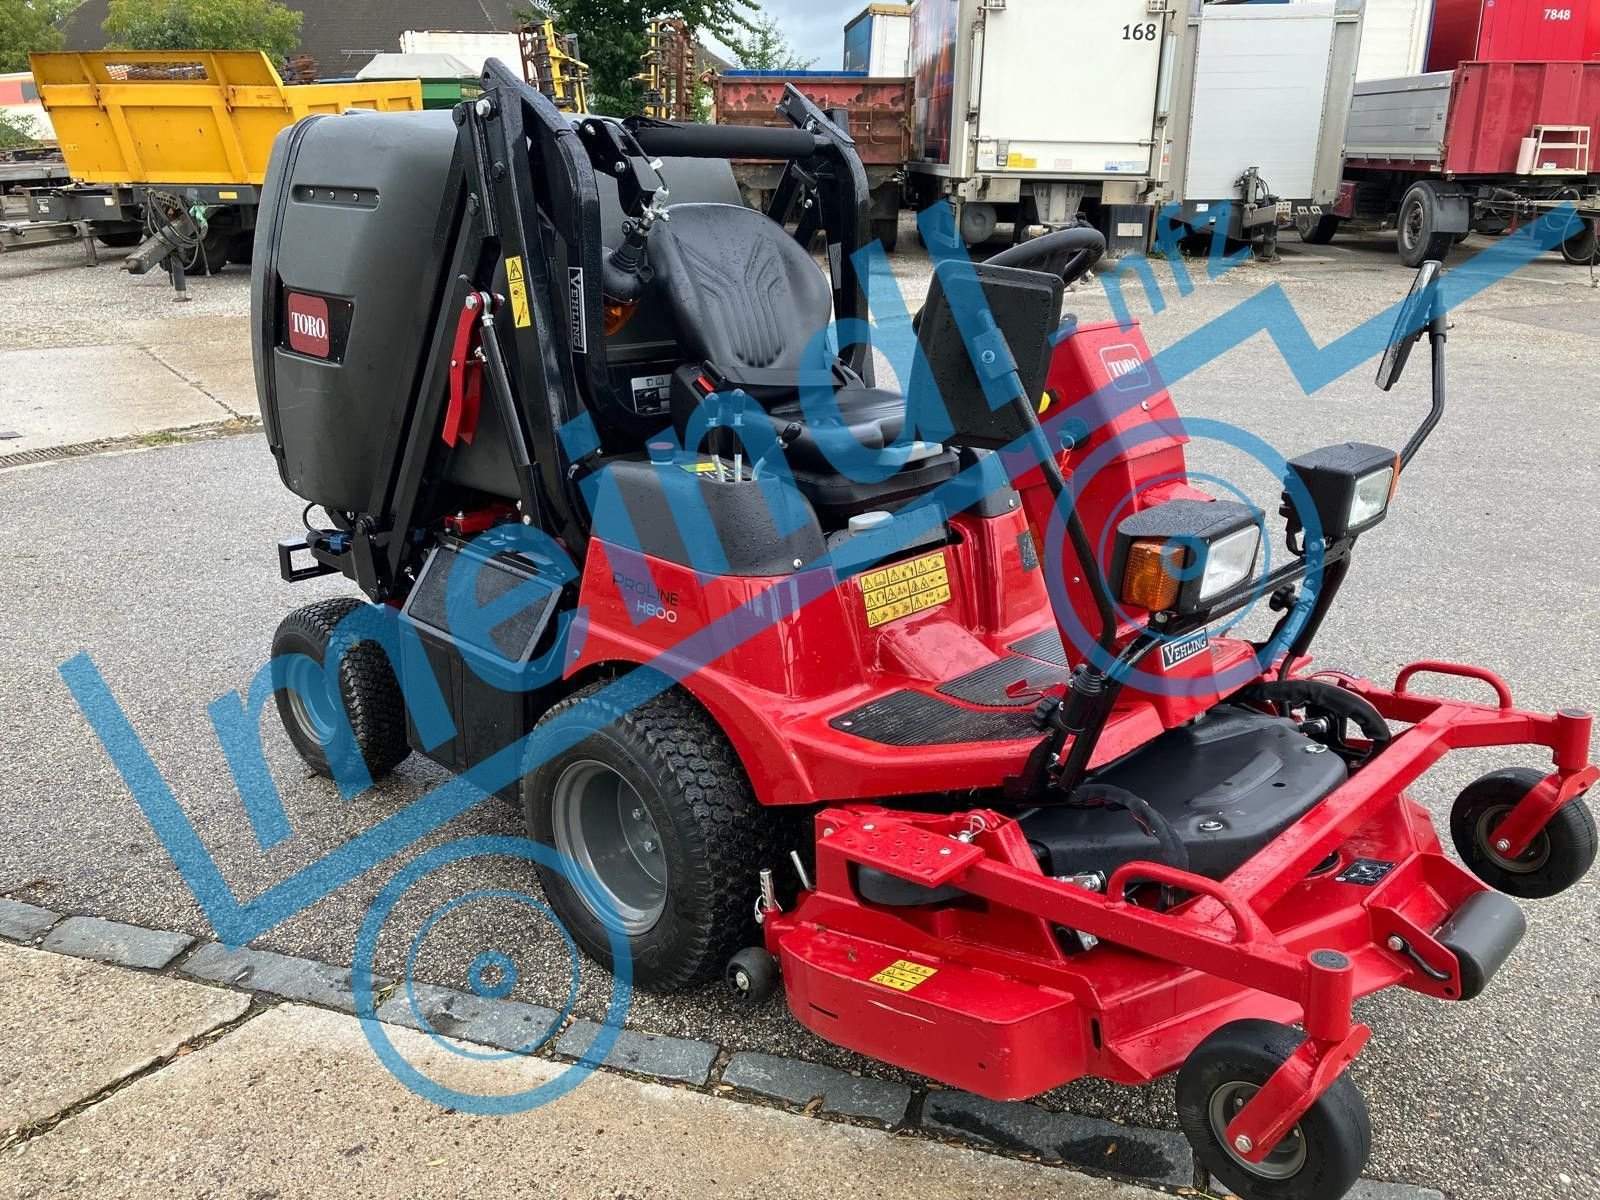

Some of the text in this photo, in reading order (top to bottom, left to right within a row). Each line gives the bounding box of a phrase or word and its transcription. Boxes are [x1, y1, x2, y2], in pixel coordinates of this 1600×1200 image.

[1544, 9, 1571, 20] 7848
[1122, 23, 1157, 41] 168
[292, 312, 326, 338] TORO
[1108, 358, 1142, 377] TORO
[637, 600, 677, 623] H800
[1164, 630, 1207, 664] VEHLING
